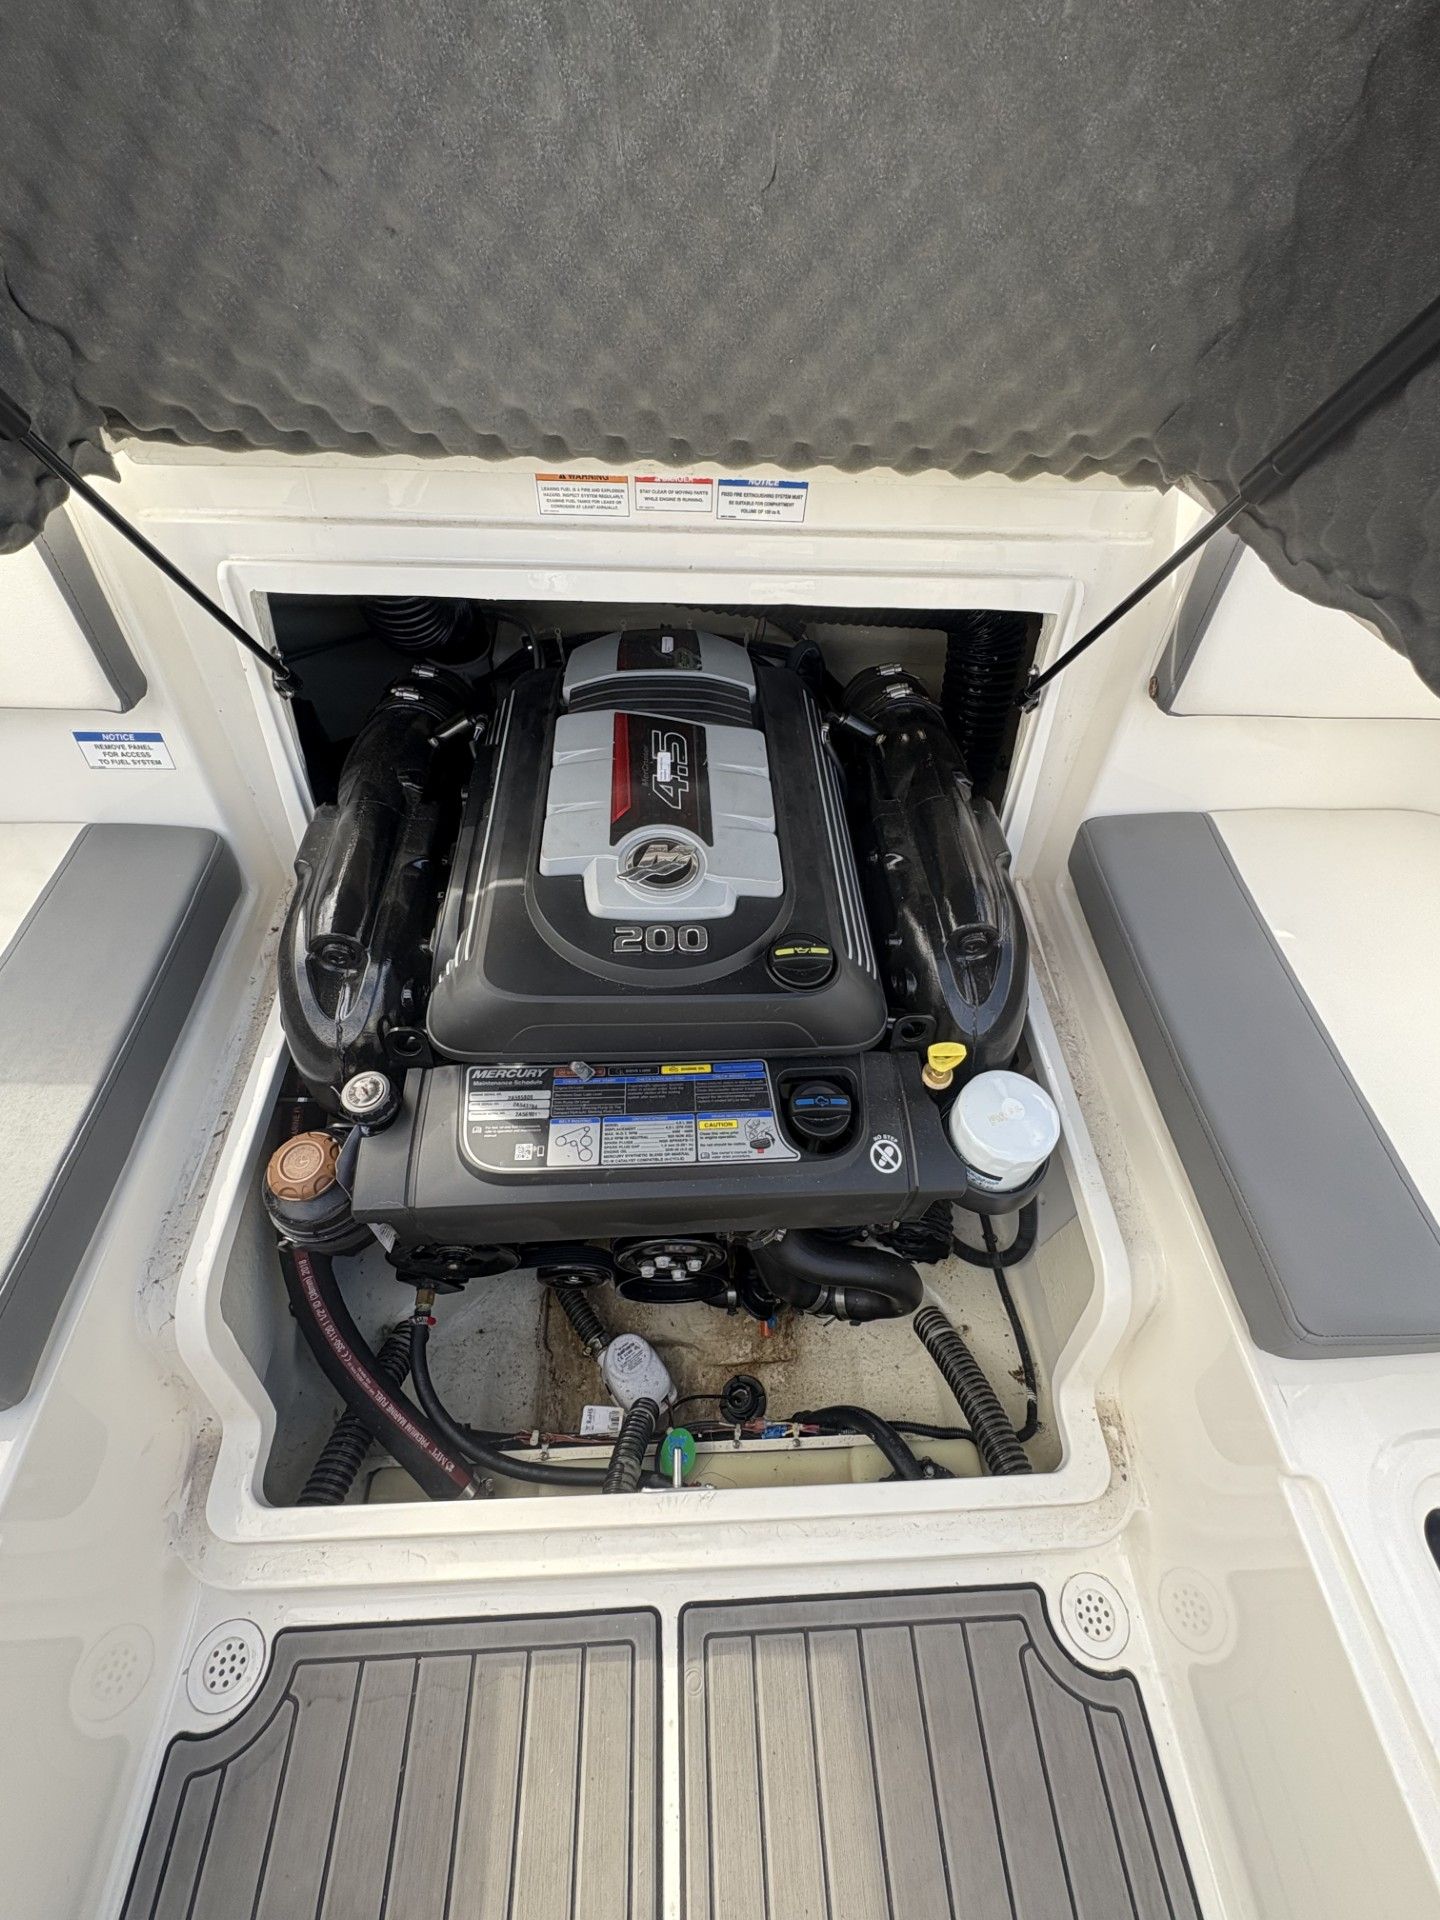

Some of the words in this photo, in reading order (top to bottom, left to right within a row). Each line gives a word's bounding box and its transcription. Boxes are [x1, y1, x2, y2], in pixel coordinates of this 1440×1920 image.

[101, 733, 135, 741] NOTICE
[613, 925, 708, 953] 200
[472, 1068, 548, 1079] MERCURY
[882, 1133, 898, 1143] STEP
[374, 1390, 388, 1408] FUEL
[385, 1402, 408, 1427] MARINE
[404, 1423, 431, 1449] PREMIUM
